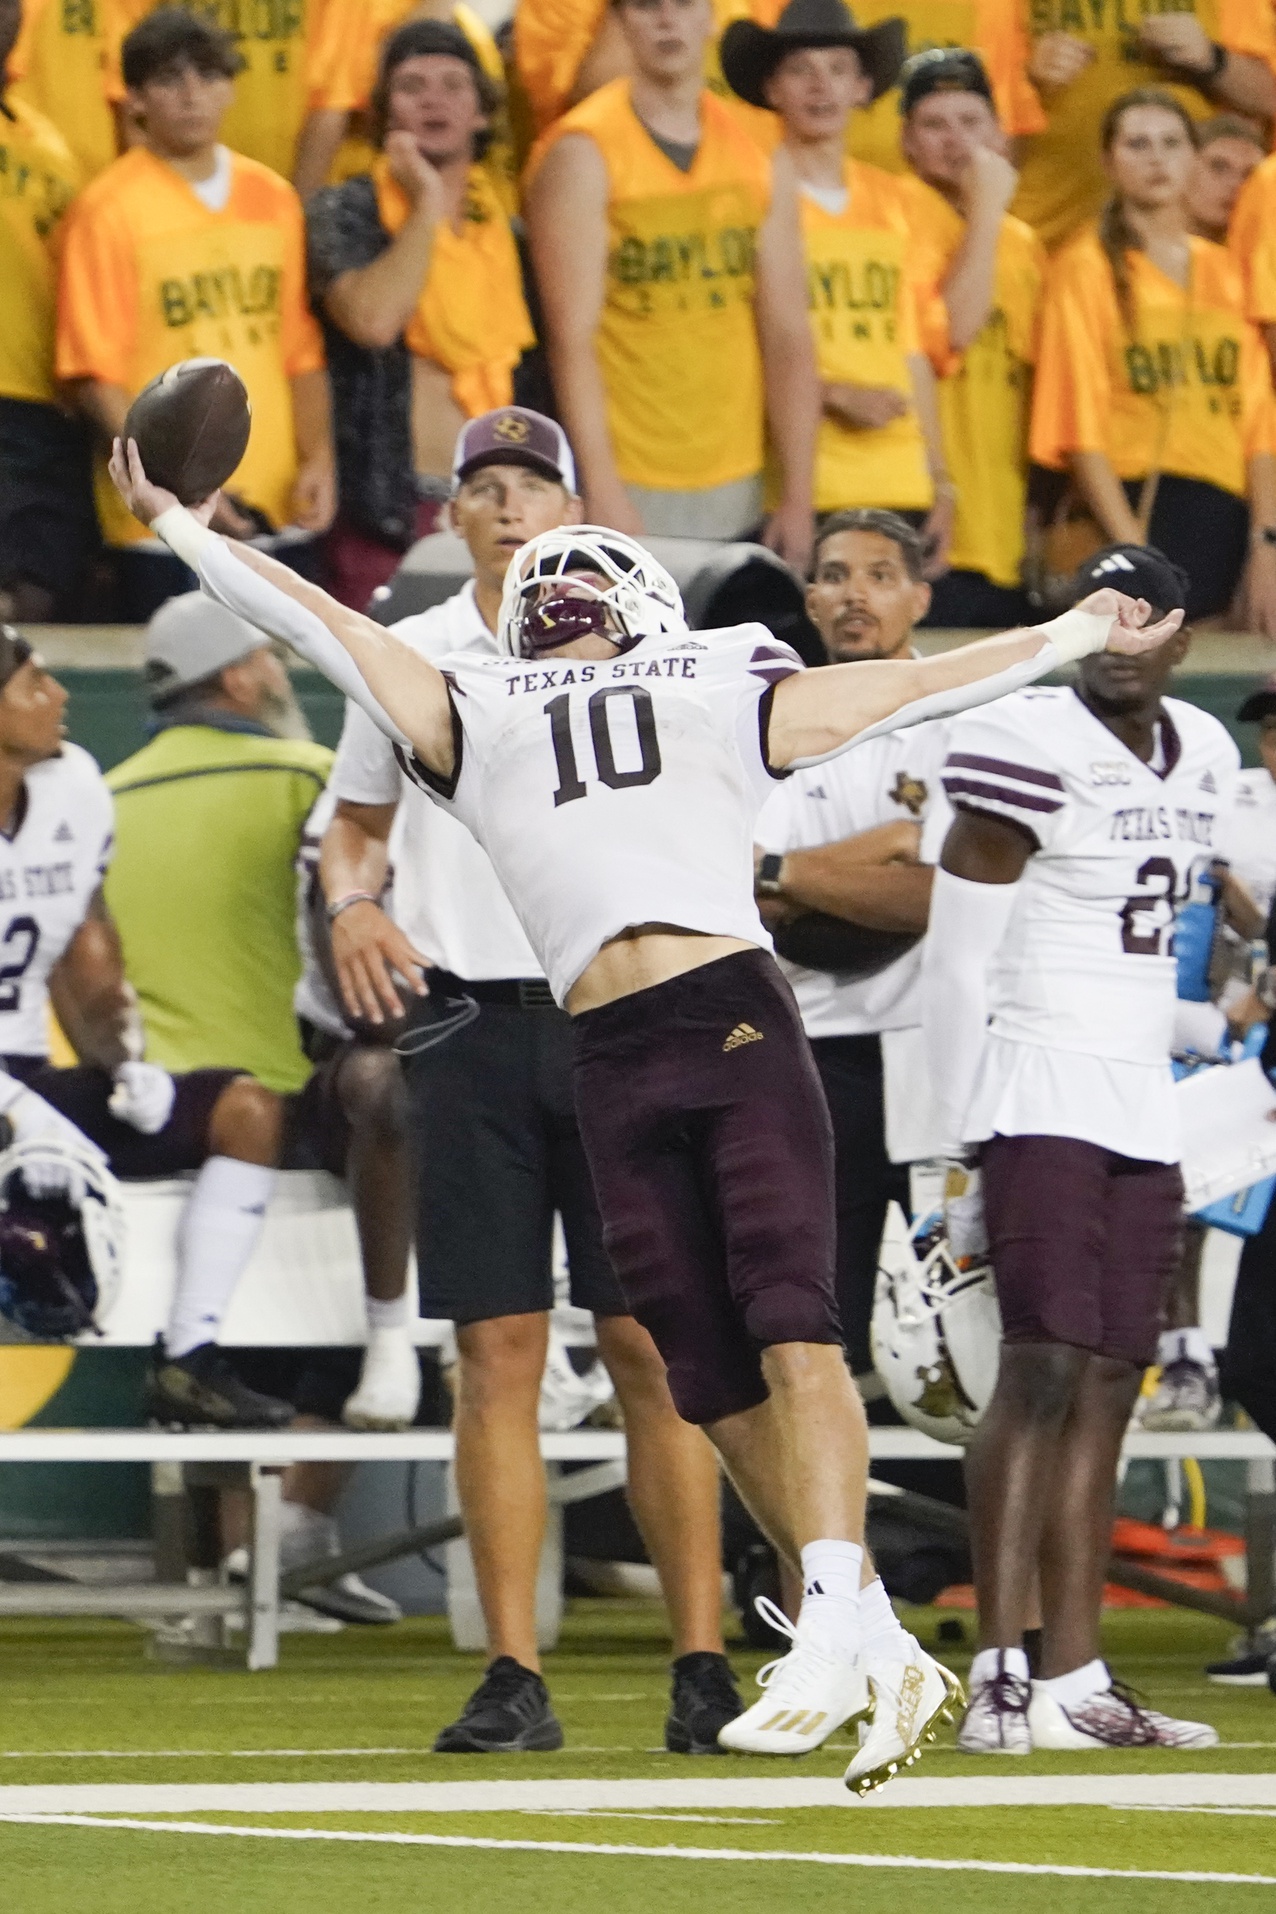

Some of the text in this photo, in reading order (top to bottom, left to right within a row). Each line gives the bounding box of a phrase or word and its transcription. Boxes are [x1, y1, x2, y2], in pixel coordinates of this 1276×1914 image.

[505, 657, 697, 696] TEXAS STATE
[543, 684, 662, 808] 10
[1109, 806, 1172, 841] TEXAS
